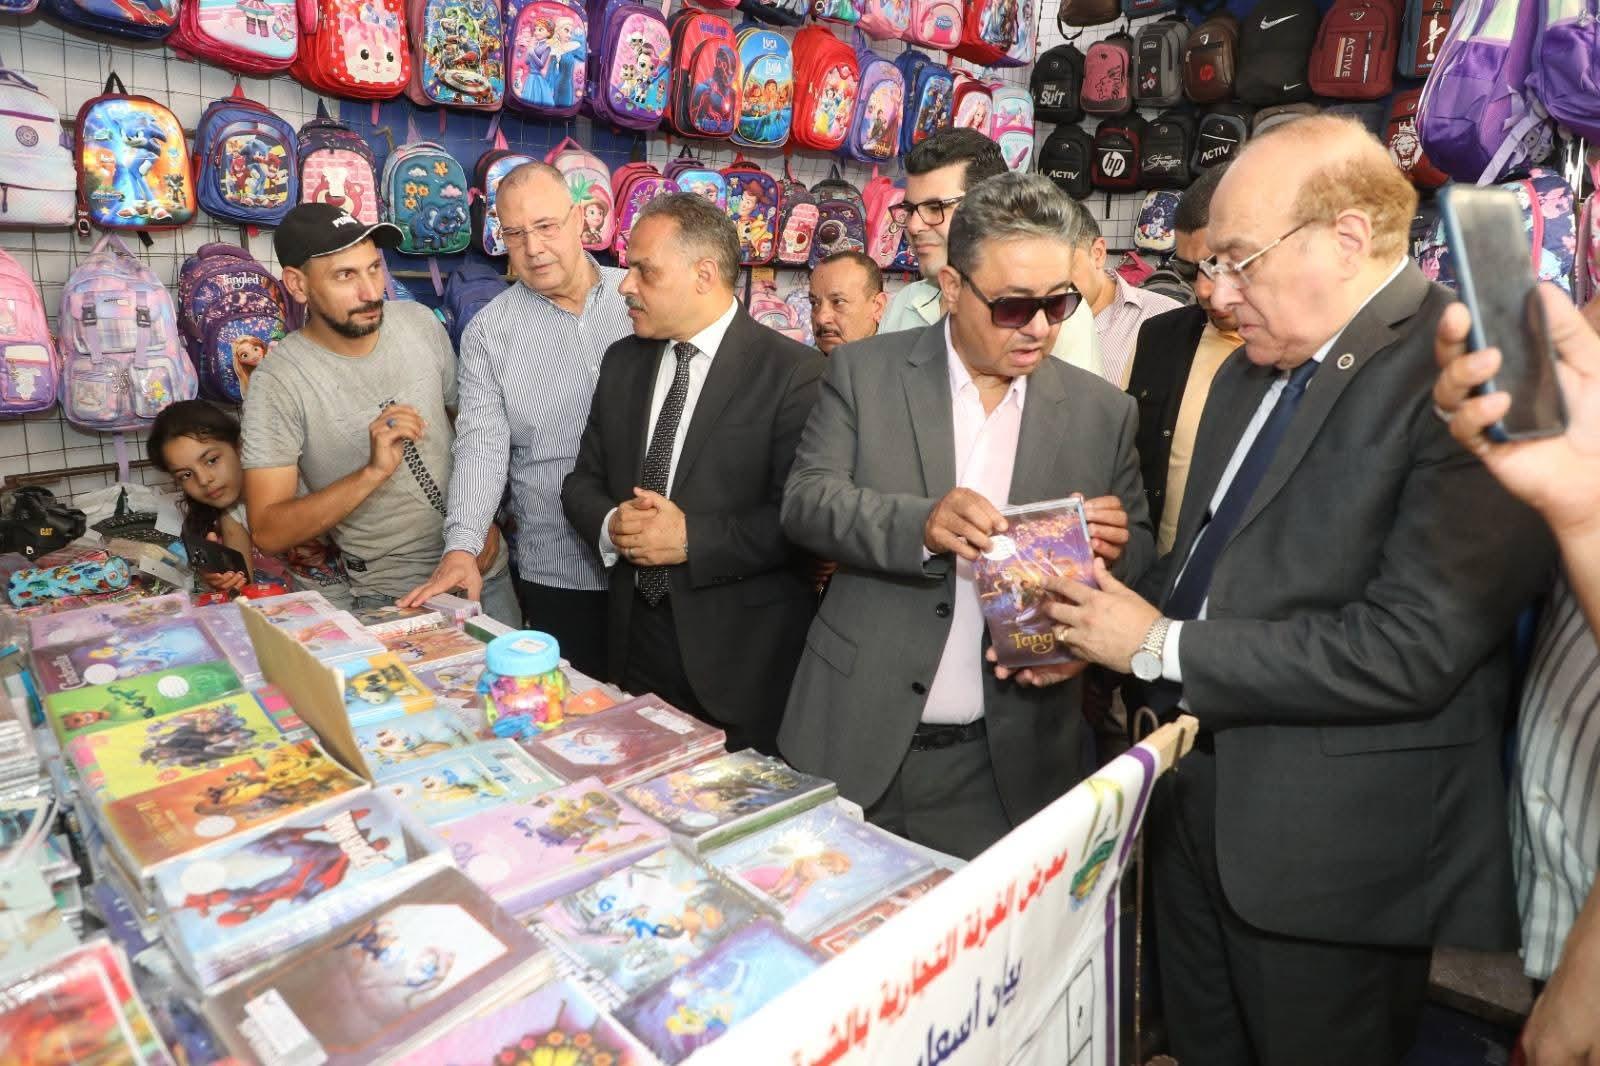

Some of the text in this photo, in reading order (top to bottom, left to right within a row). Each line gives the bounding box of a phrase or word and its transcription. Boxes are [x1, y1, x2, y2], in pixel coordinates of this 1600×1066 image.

[1342, 37, 1356, 78] ACTIVE
[1040, 89, 1065, 105] SUIT
[1103, 151, 1124, 177] hp
[1201, 143, 1230, 164] ACTIV
[1049, 170, 1079, 180] ACTIV
[219, 272, 259, 290] Tangled
[40, 527, 53, 536] CAT
[1008, 631, 1055, 654] Tang
[1019, 848, 1068, 911] معرض
[963, 879, 1017, 949] الغرفة
[879, 924, 958, 1023] التجارية
[987, 953, 1023, 1027] بيان
